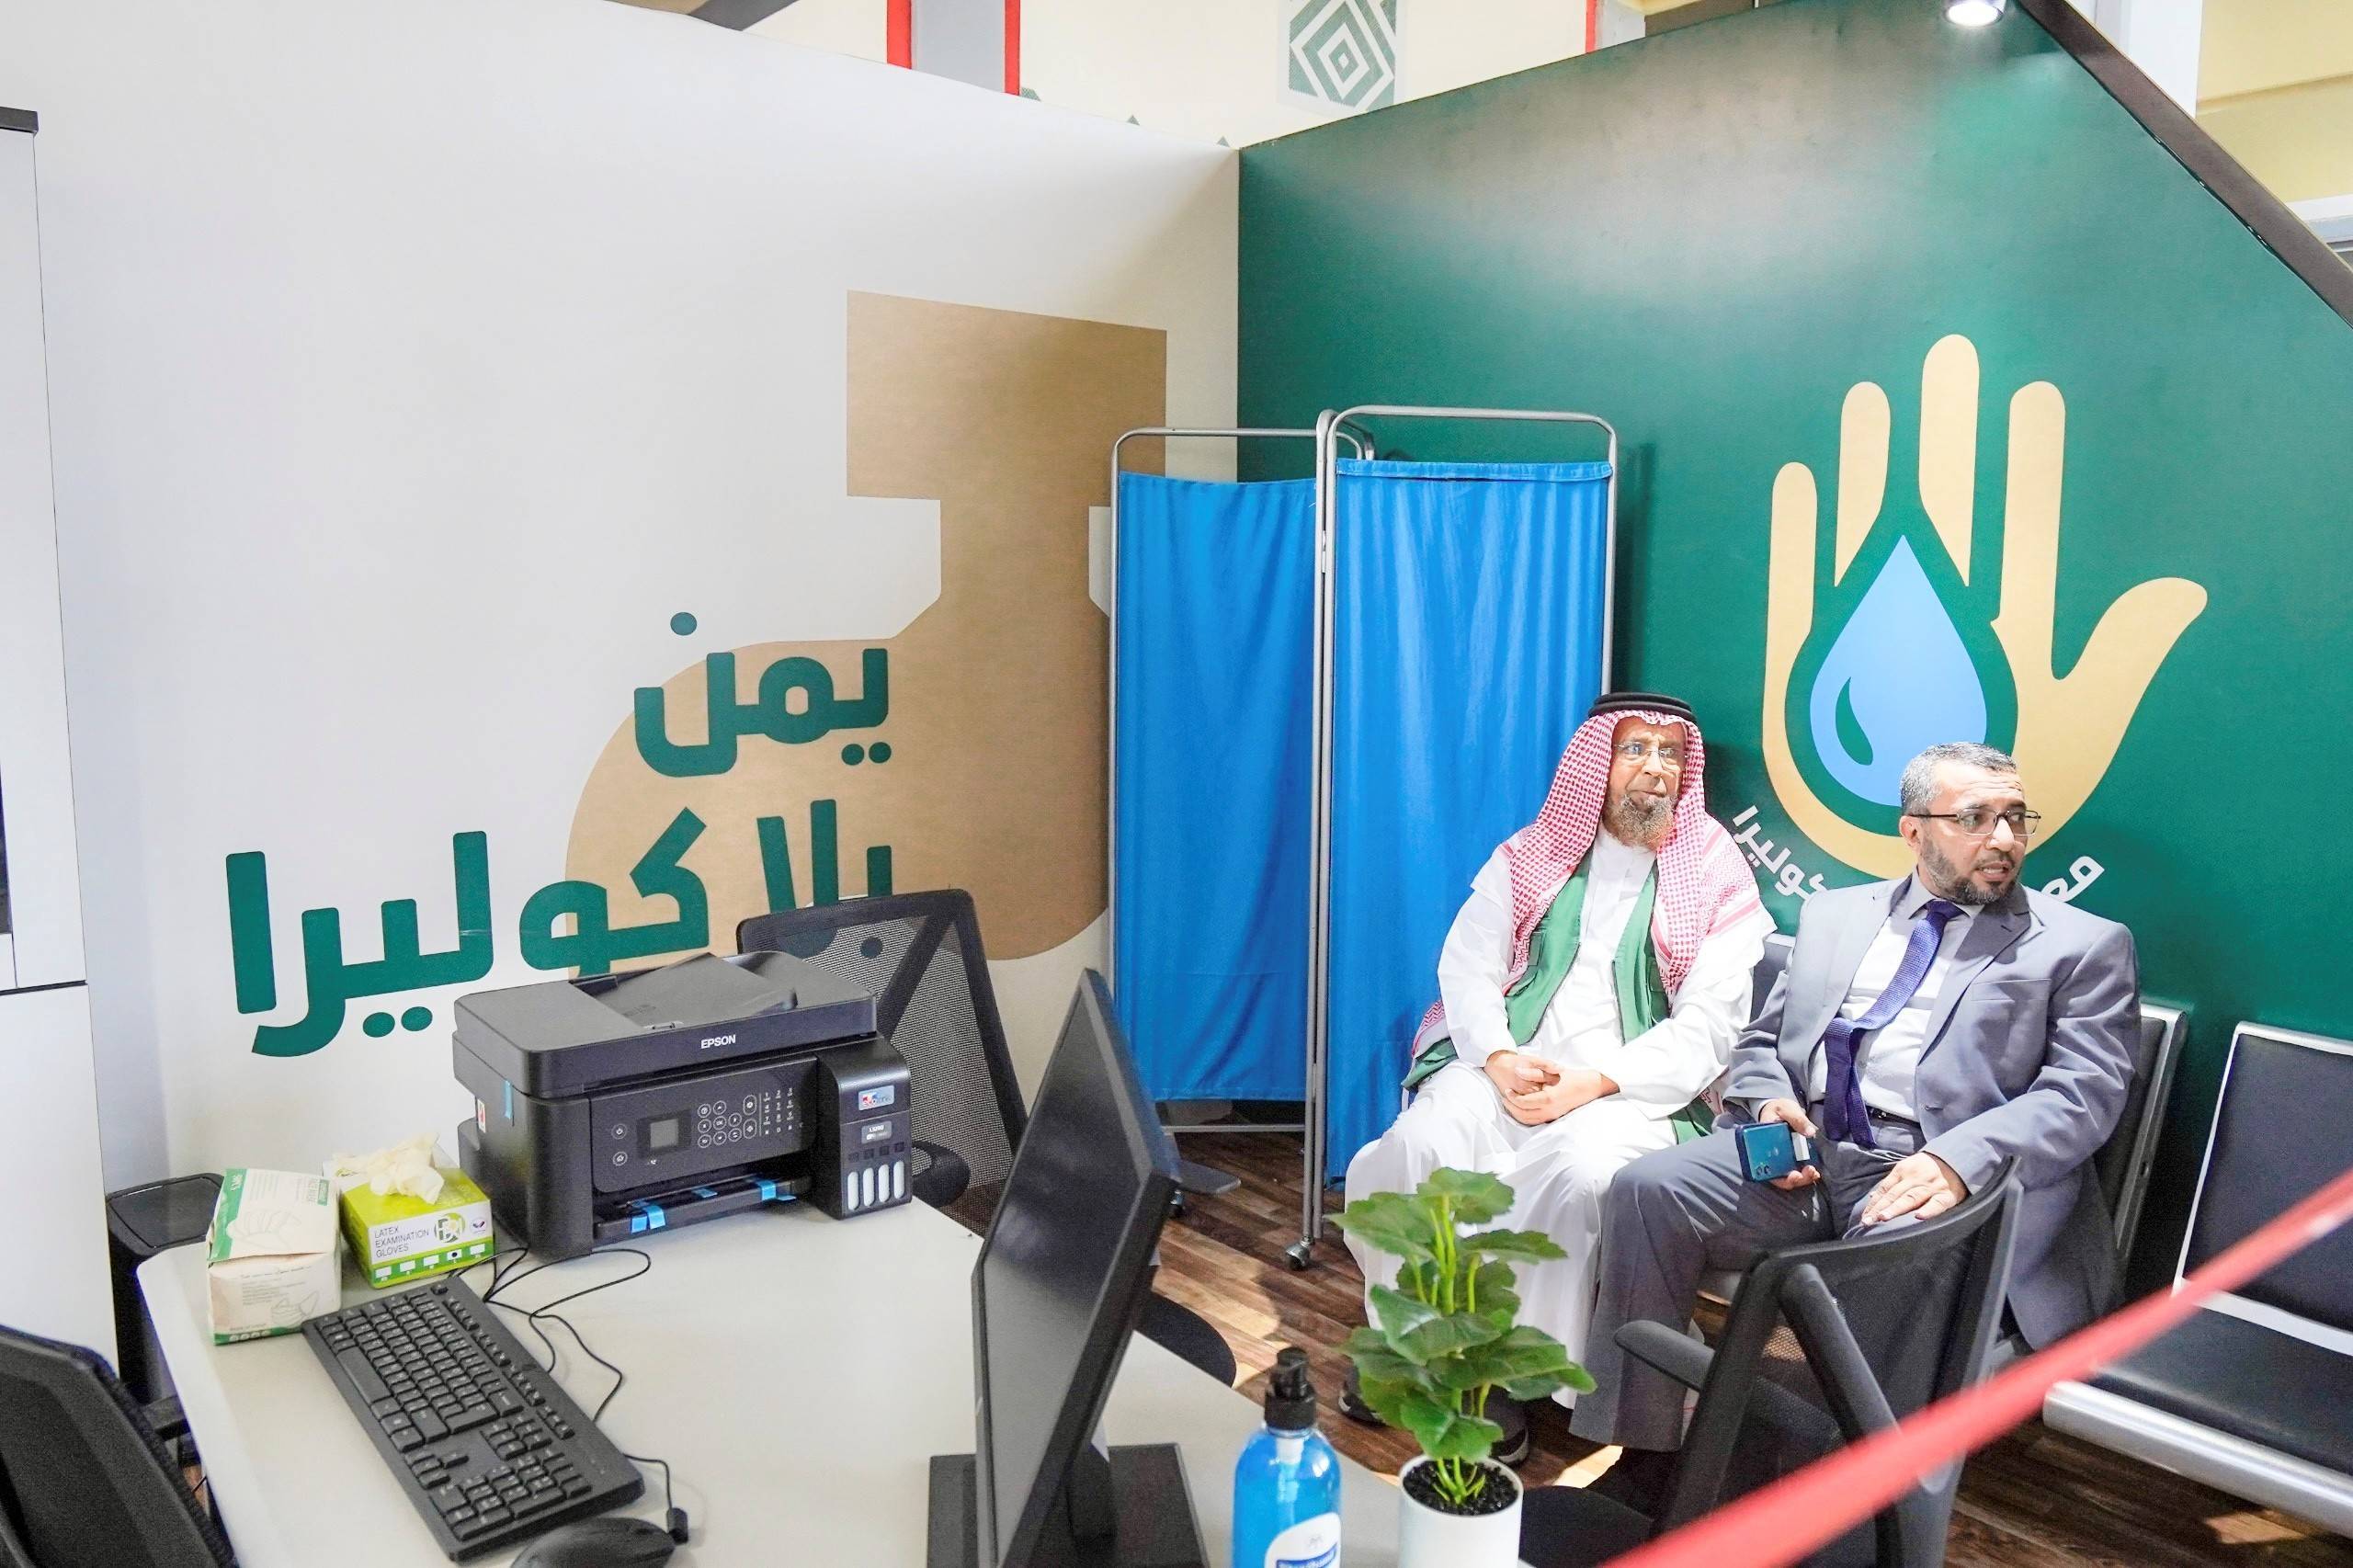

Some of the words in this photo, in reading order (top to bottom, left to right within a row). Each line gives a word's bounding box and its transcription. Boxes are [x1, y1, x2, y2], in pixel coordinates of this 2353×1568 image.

[634, 612, 892, 777] يمن
[225, 806, 709, 1058] كوليرا
[700, 1034, 736, 1049] EPSON
[375, 1225, 394, 1239] LATEX
[375, 1229, 429, 1249] EXAMINATION
[376, 1244, 409, 1259] GLOVES
